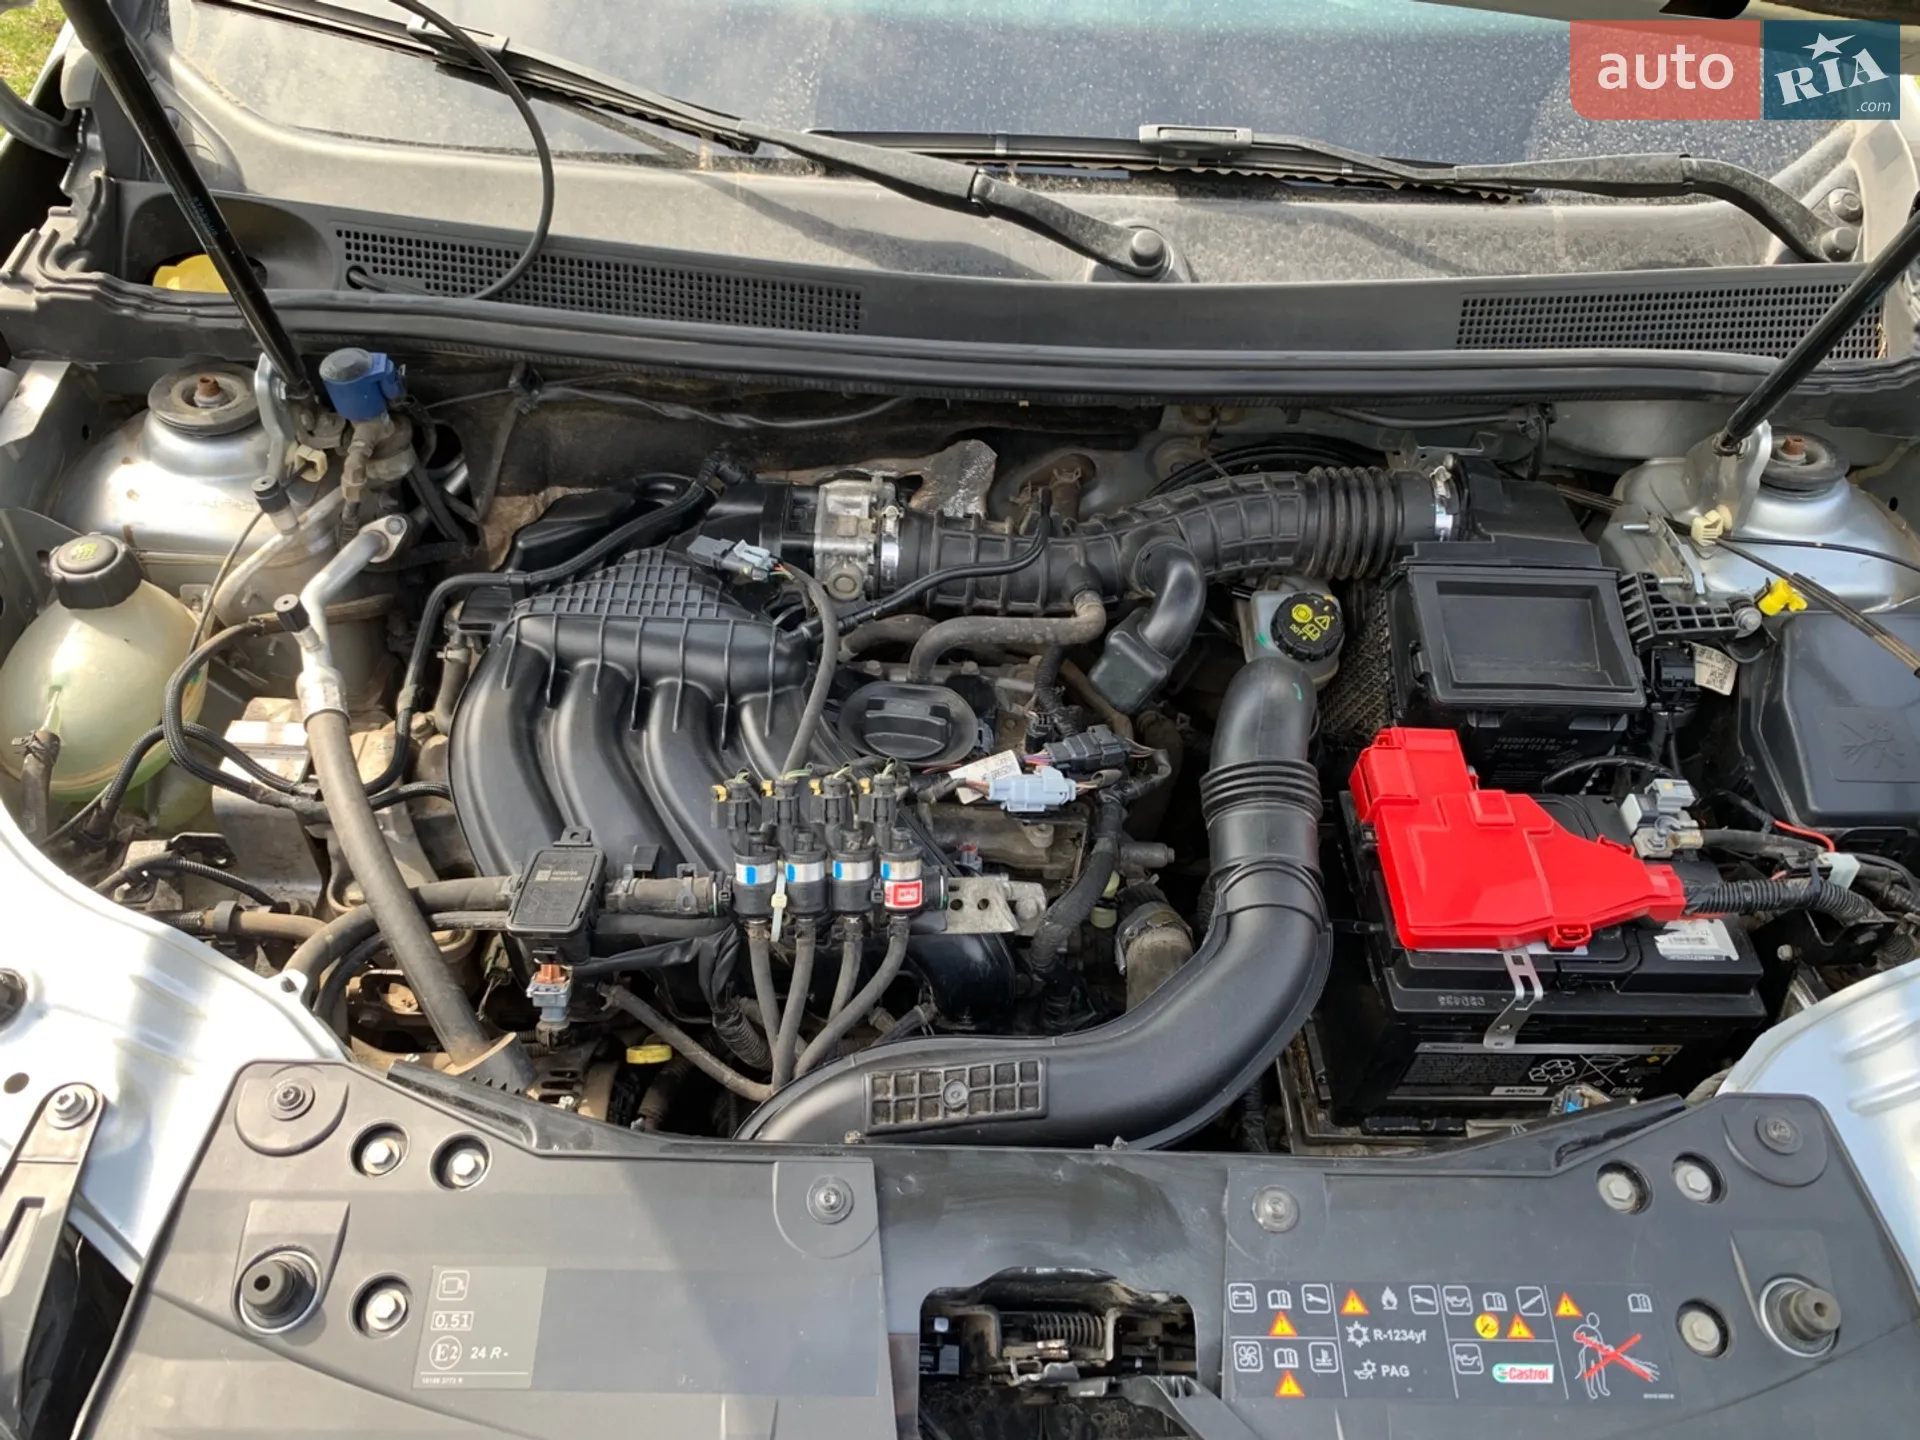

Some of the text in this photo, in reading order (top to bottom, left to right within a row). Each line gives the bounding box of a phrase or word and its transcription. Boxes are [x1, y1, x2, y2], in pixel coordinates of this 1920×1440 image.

[434, 1313, 470, 1329] 0,51
[1373, 1328, 1427, 1344] R-1234yf
[470, 1346, 487, 1360] 24
[1381, 1365, 1410, 1377] PAG
[1508, 1366, 1550, 1381] Castrol
